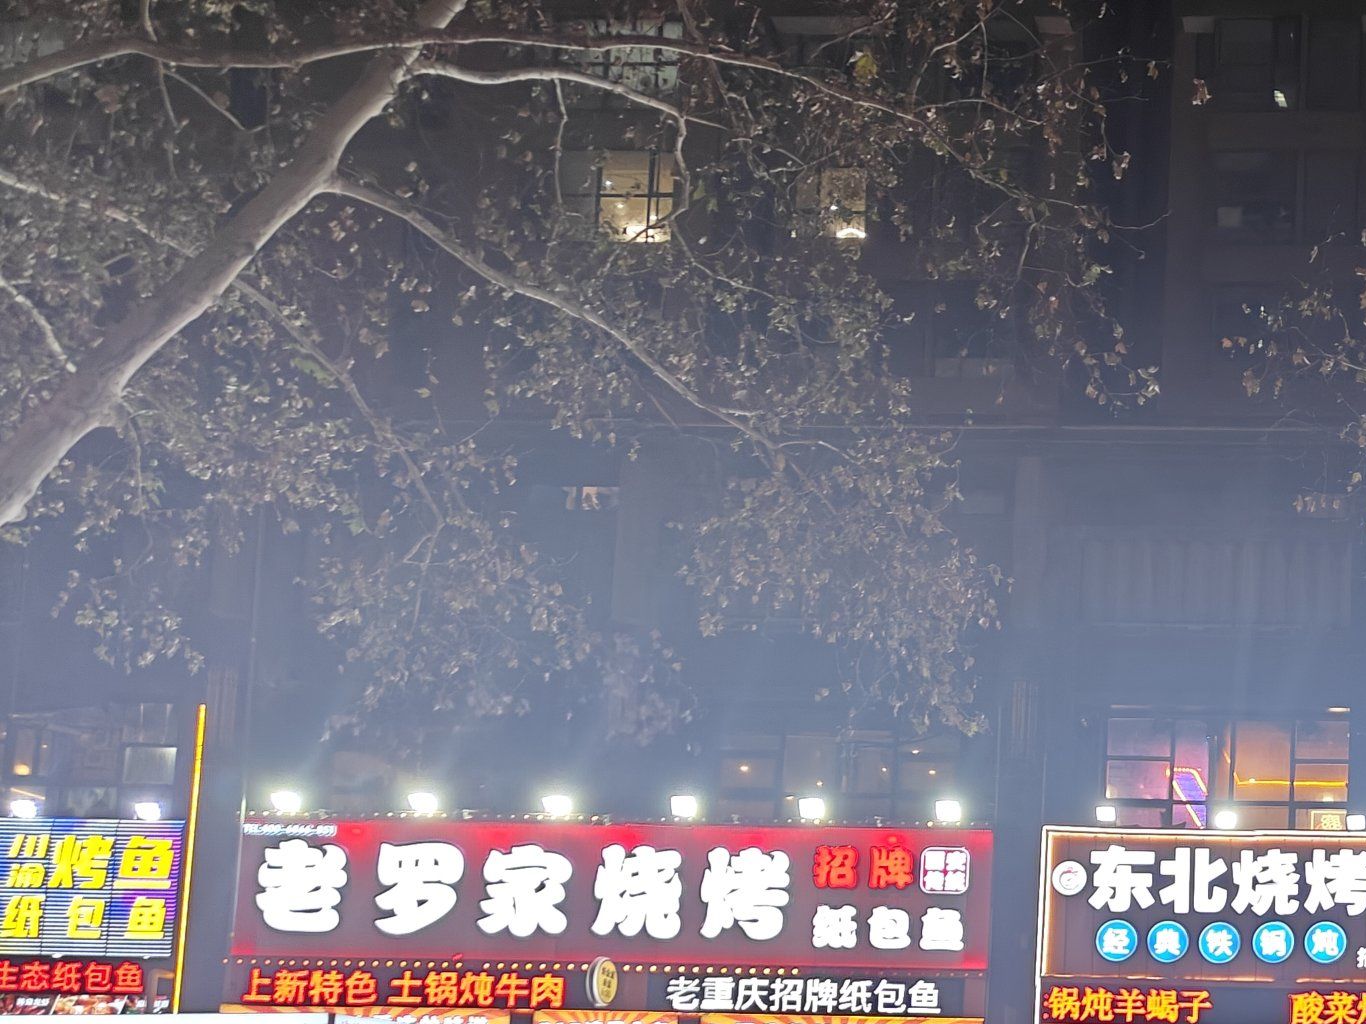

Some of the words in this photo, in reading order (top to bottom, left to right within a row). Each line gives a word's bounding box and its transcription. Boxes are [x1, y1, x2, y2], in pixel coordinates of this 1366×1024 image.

[812, 845, 913, 889] 招牌
[256, 838, 790, 941] 老罗家烧烤
[0, 894, 167, 939] 纸包鱼
[812, 905, 965, 951] 纸包鱼
[1100, 925, 1342, 960] 经典铁锅炖
[0, 961, 143, 993] 生态纸包鱼
[242, 968, 378, 1004] 上新特色
[387, 970, 565, 1008] 土锅炖牛肉
[666, 975, 942, 1015] 老重庆招牌纸包鱼
[1045, 986, 1213, 1024] 锅炖羊蝎子
